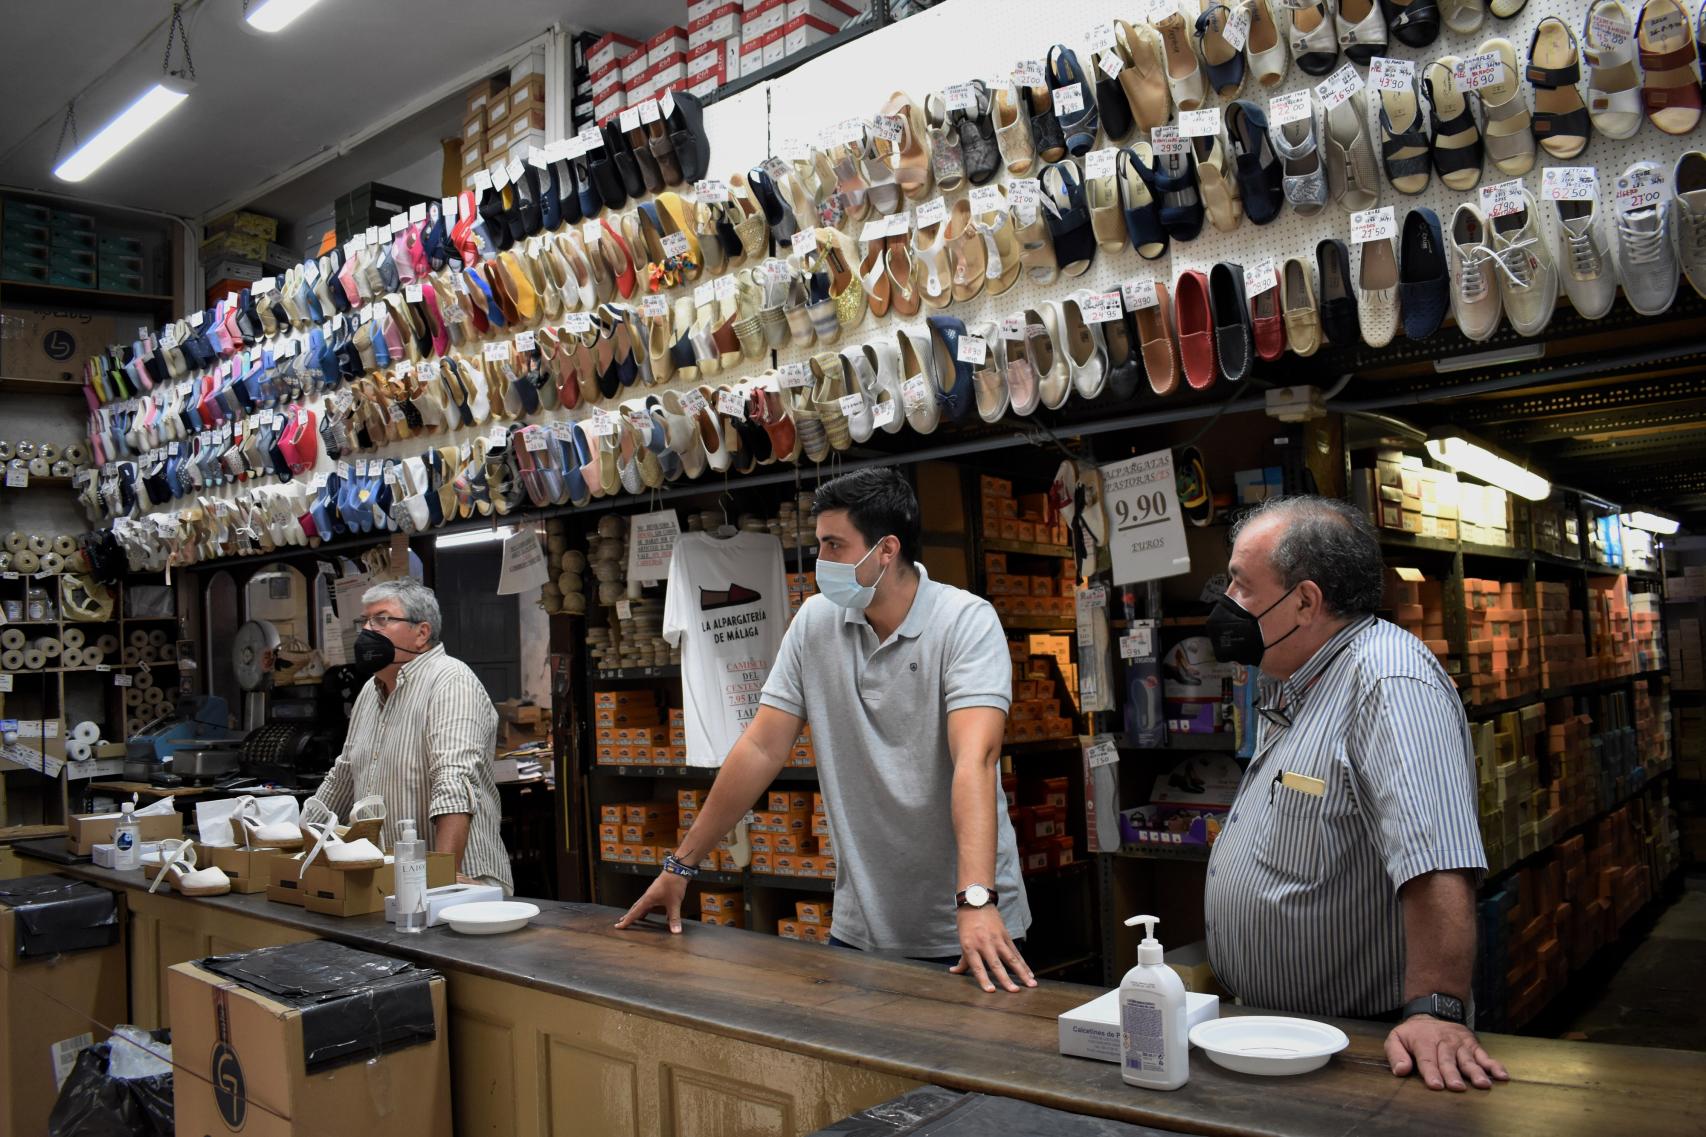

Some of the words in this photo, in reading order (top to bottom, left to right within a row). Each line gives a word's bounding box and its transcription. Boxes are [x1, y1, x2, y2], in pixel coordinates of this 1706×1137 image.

[1103, 455, 1170, 481] ALPARGATAS
[1104, 472, 1156, 493] PASTORAS
[1115, 490, 1167, 525] 9.90
[1131, 537, 1164, 553] EUROS
[701, 621, 711, 633] LA
[713, 611, 767, 630] ALPARGATERÍA
[714, 632, 724, 644] DE
[726, 626, 759, 642] MÁLAGA
[742, 672, 759, 680] DEL
[729, 694, 746, 705] 7.95
[1072, 1026, 1106, 1038] Calcetines
